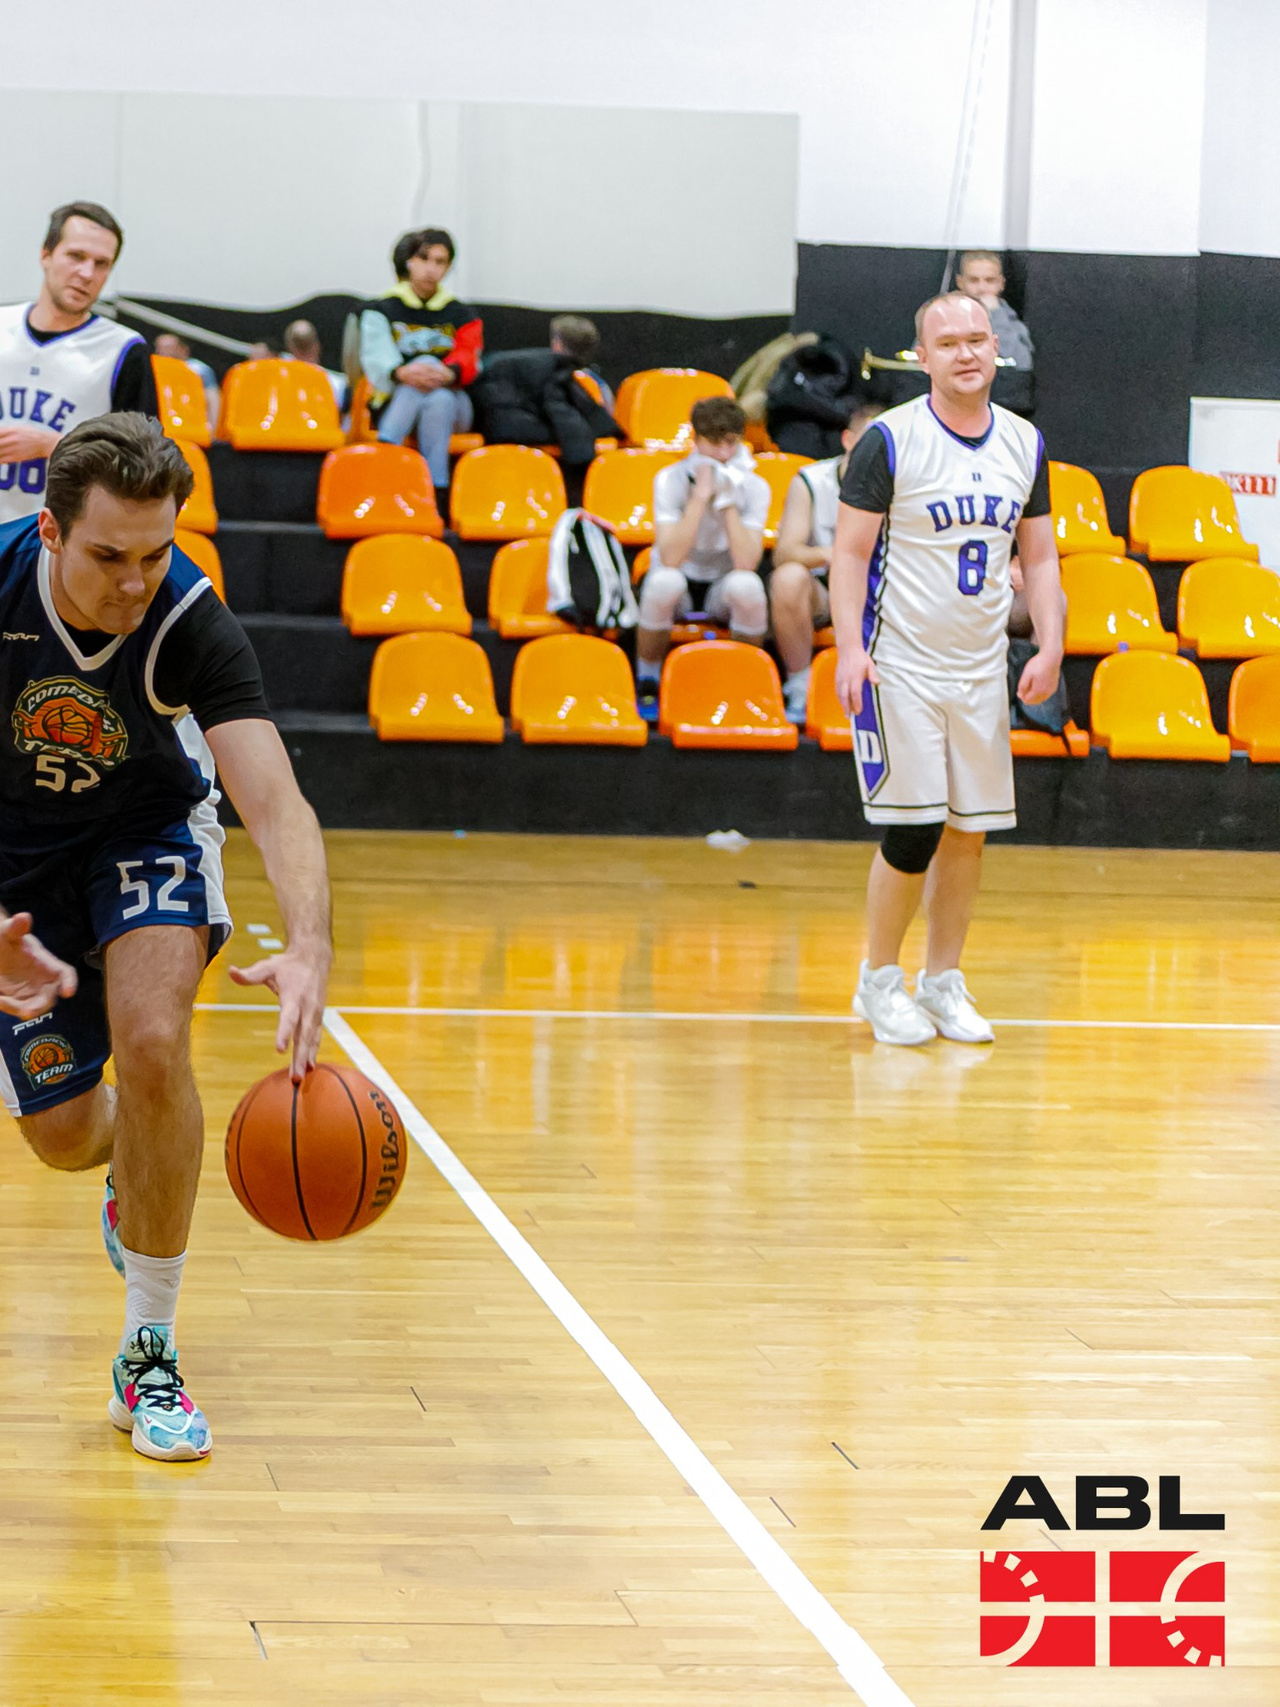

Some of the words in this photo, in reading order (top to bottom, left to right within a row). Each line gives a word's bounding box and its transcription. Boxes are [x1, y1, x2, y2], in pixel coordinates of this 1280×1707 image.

[926, 494, 1021, 534] DUKE
[958, 540, 988, 596] 8
[35, 754, 100, 793] 52
[116, 856, 189, 920] 52
[34, 1063, 74, 1084] TEAM
[369, 1090, 400, 1208] Wilson
